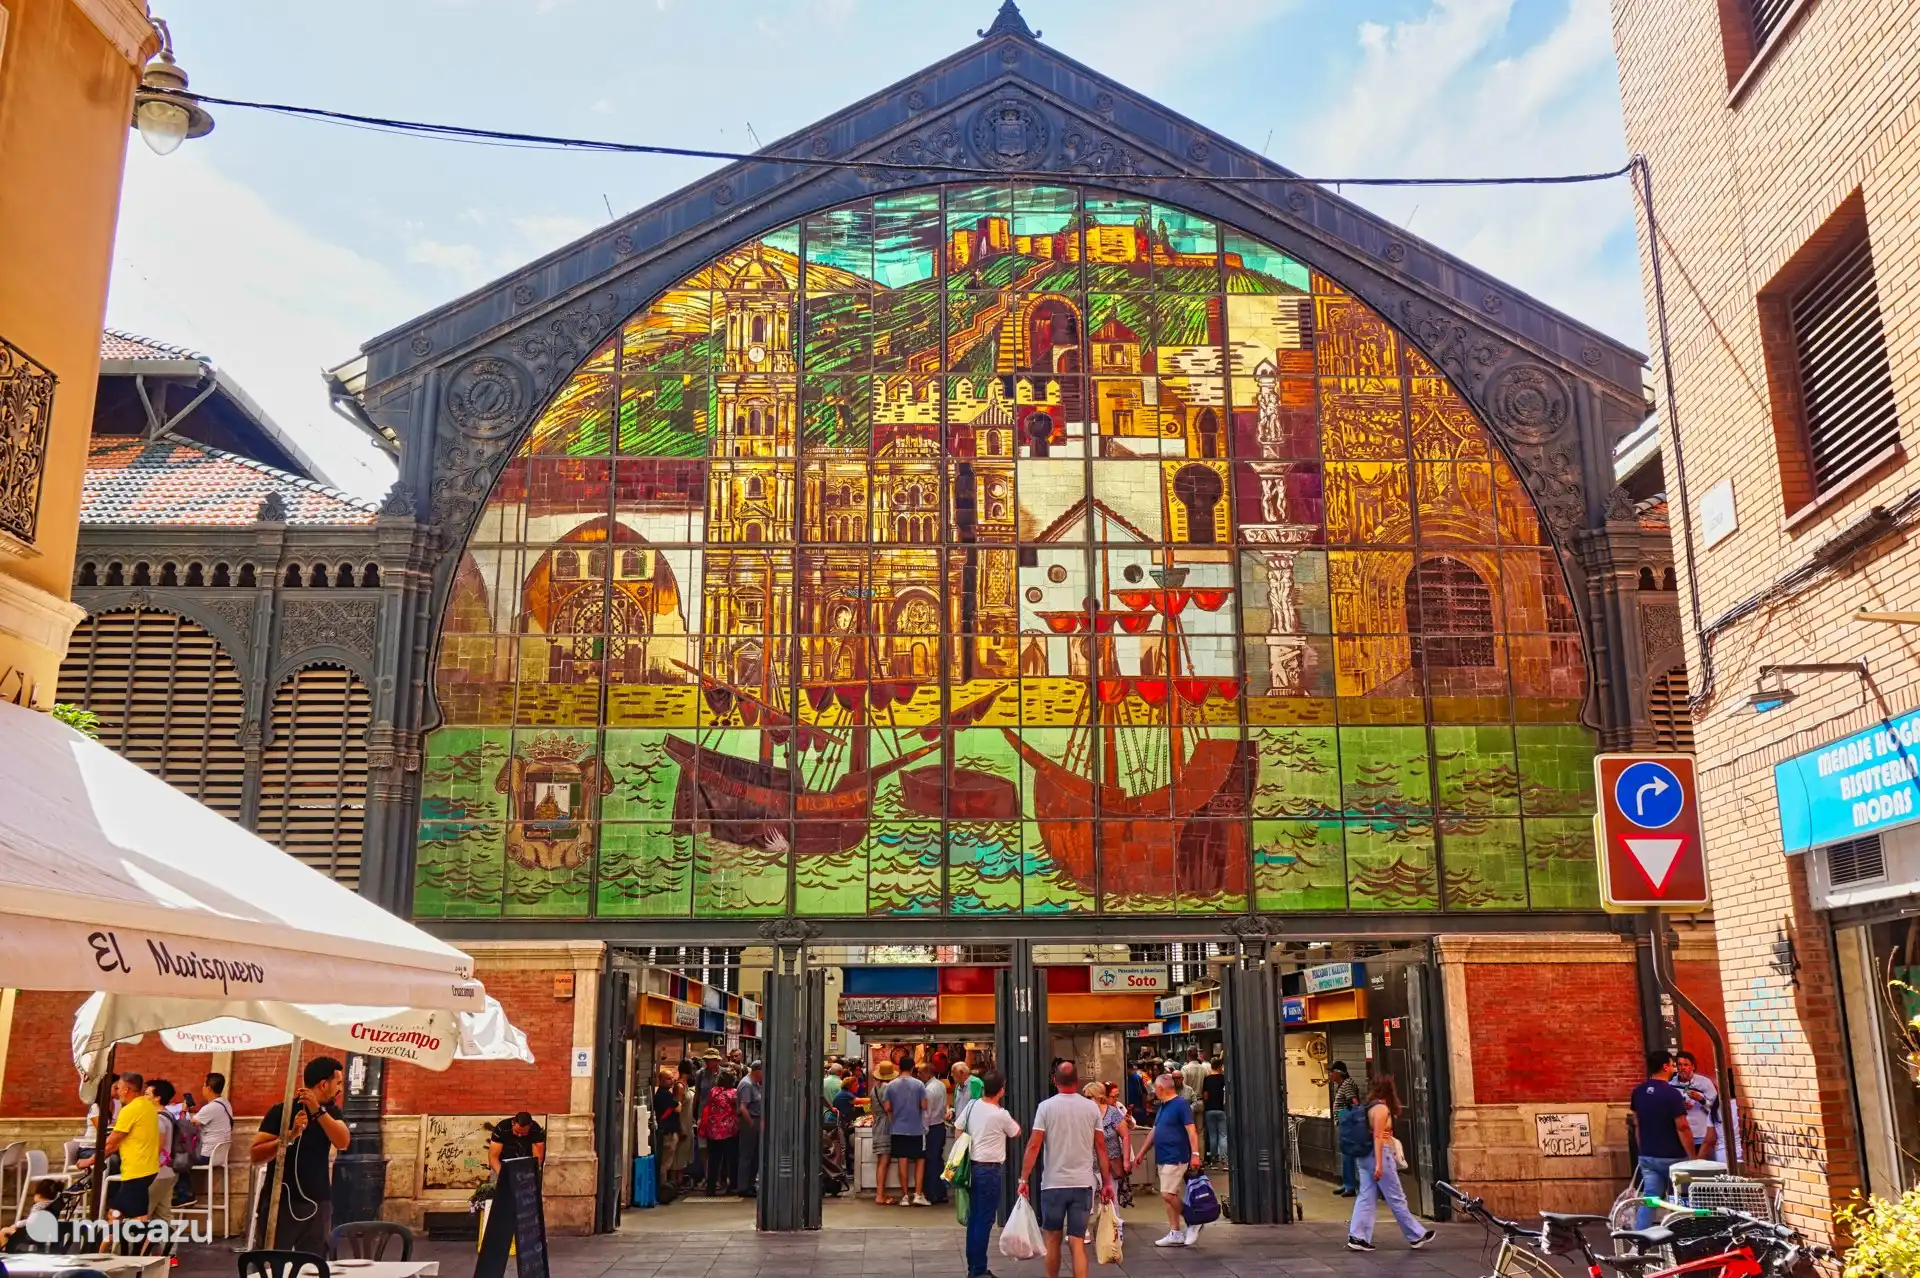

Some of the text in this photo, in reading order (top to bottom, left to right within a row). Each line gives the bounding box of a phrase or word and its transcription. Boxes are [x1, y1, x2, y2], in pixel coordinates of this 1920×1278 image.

[1817, 736, 1873, 777] MENAJE
[1840, 753, 1919, 800] BISUTERIA
[1852, 787, 1913, 827] MODAS
[87, 931, 265, 996] El Marisquero
[1127, 975, 1157, 987] Soto
[350, 1022, 441, 1051] Cruzcampo
[367, 1045, 419, 1060] ESPECIAL
